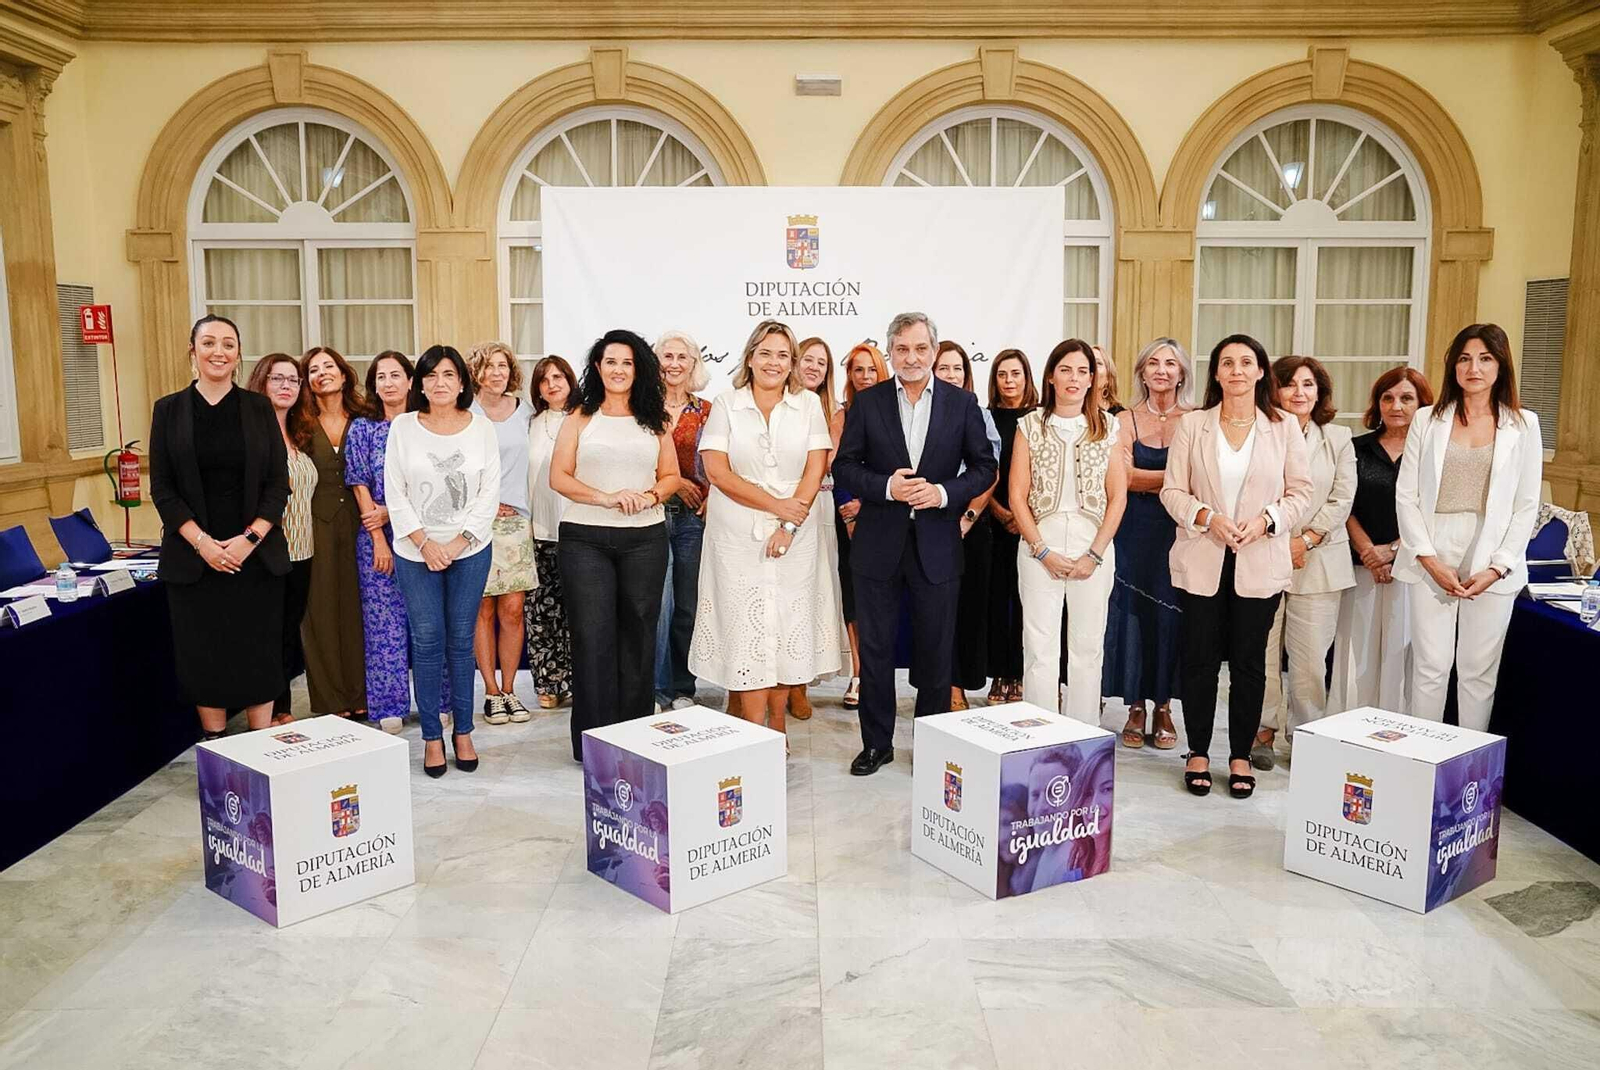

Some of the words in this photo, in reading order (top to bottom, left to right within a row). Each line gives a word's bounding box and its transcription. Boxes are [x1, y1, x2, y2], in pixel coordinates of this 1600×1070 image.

[745, 278, 860, 296] DIPUTACIÓN
[747, 302, 772, 316] DE
[777, 298, 858, 316] ALMERÍA
[592, 802, 634, 828] TRABAJANDO
[634, 822, 649, 836] POR
[922, 806, 985, 849] DIPUTACIÓN
[1010, 811, 1069, 830] TRABAJANDO
[1070, 806, 1088, 818] POR
[1089, 804, 1100, 814] LA
[1010, 808, 1100, 865] igualdad
[208, 826, 267, 877] igualdad
[296, 833, 396, 875] DIPUTACIÓN
[593, 811, 660, 865] igualdad
[687, 825, 773, 864] DIPUTACIÓN
[923, 824, 936, 841] DE
[938, 831, 983, 866] ALMERÍA
[1305, 820, 1408, 862] DIPUTACIÓN
[1306, 838, 1326, 856] DE
[1330, 846, 1403, 879] ALMERÍA
[1437, 812, 1494, 874] igualdad
[299, 875, 322, 893] DE
[326, 852, 395, 885] ALMERÍA
[690, 865, 708, 881] DE
[712, 843, 771, 873] ALMERÍA
